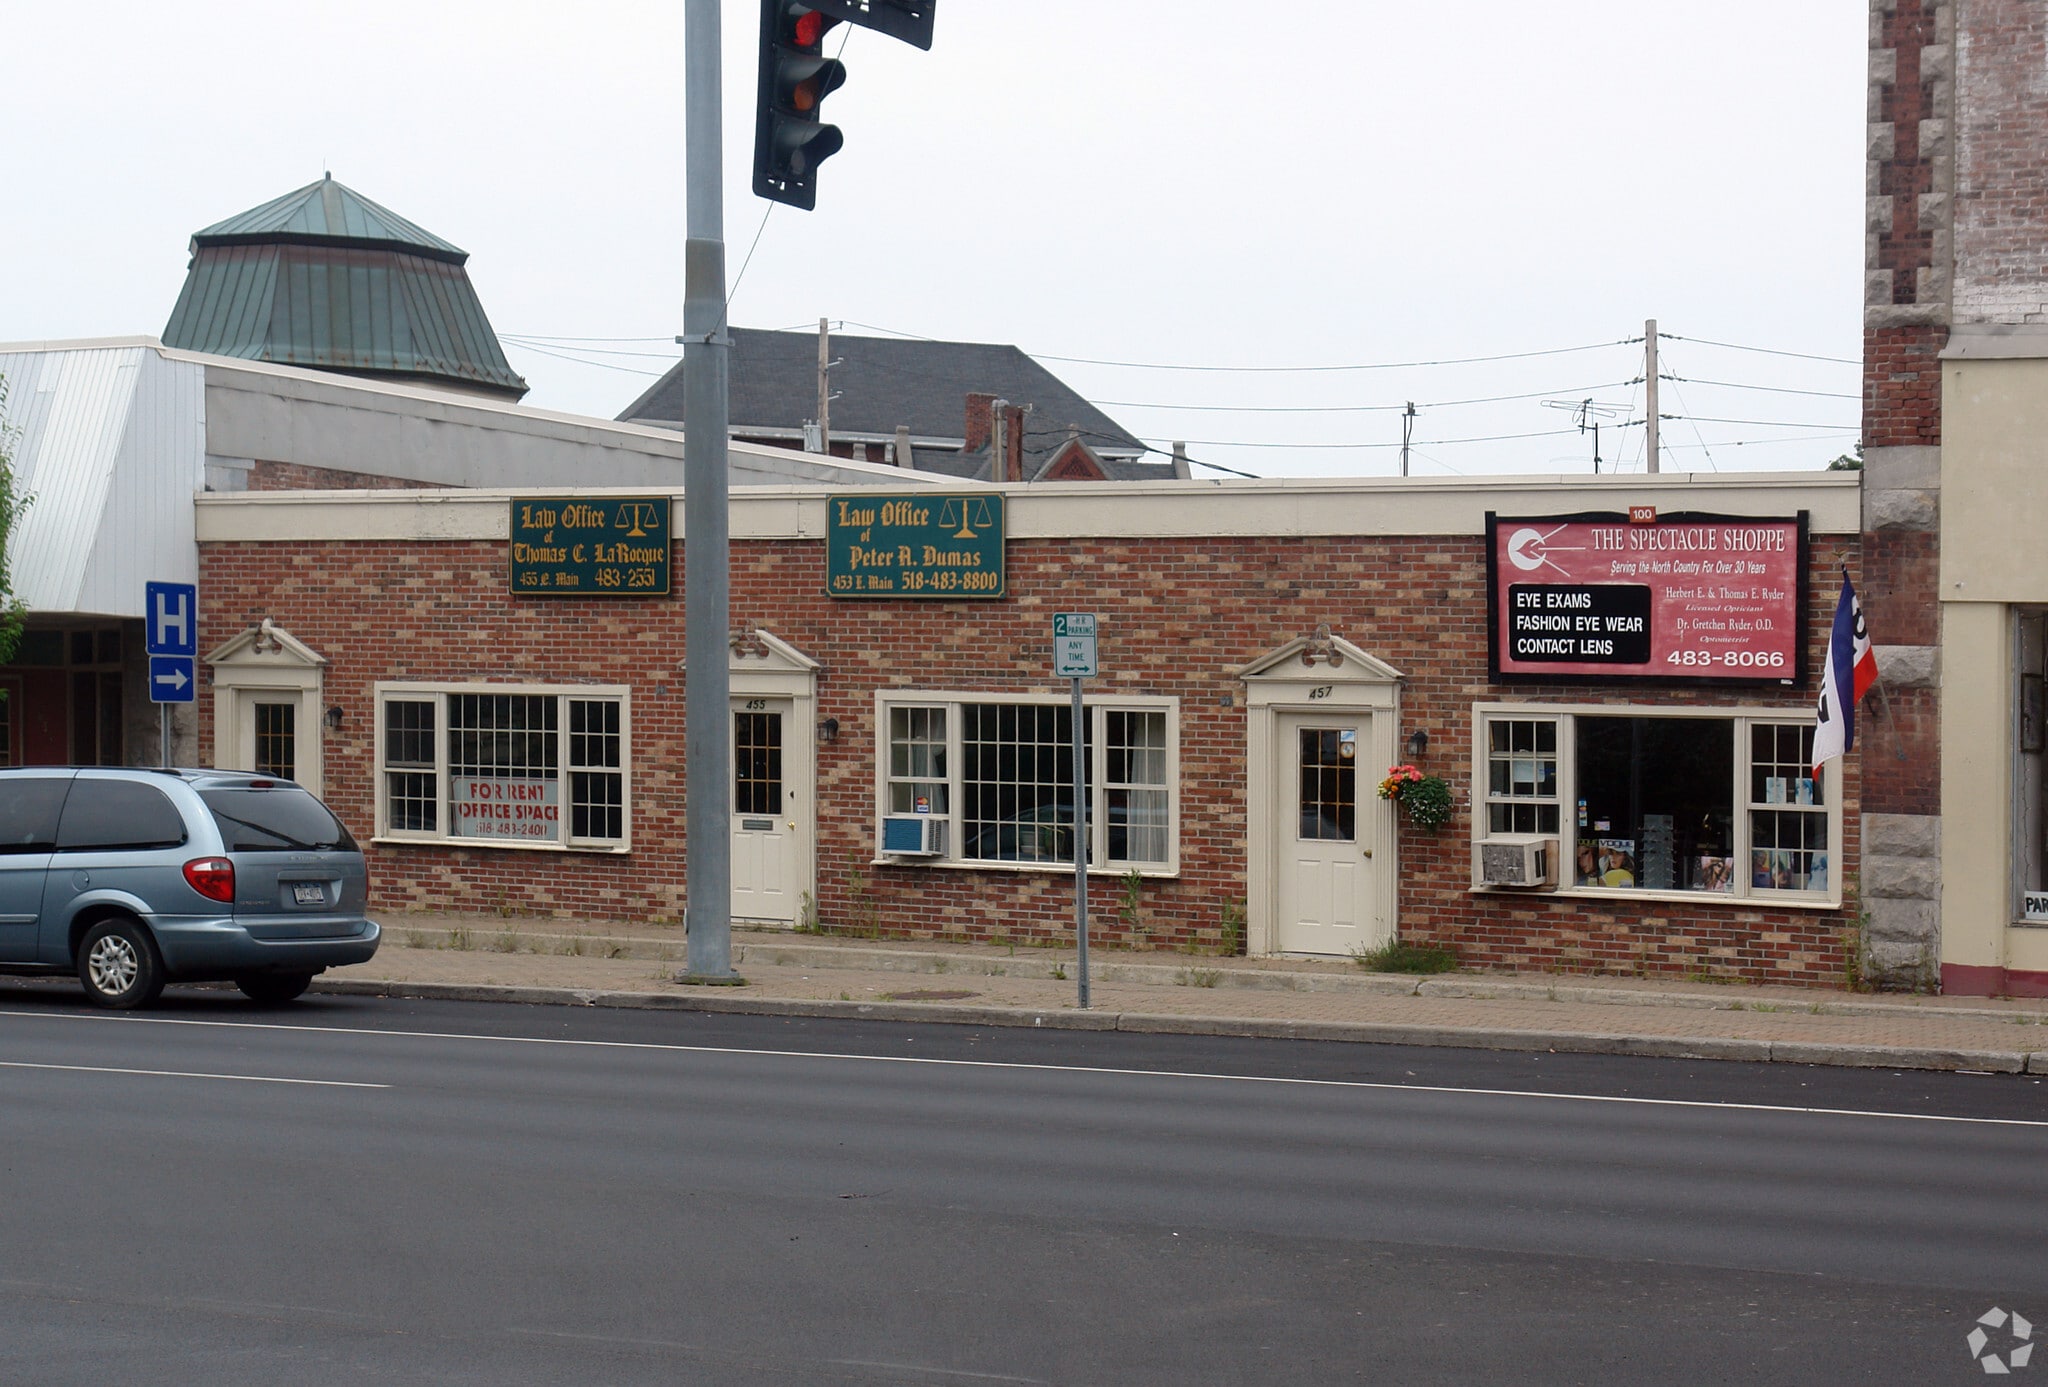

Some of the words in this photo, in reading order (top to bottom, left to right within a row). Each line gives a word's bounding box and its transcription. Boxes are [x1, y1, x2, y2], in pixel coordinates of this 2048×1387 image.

[522, 504, 556, 529] Law
[561, 504, 605, 529] Office
[838, 501, 875, 527] Law
[880, 501, 929, 527] Office
[1633, 509, 1652, 519] 100
[544, 530, 554, 543] of
[860, 528, 871, 542] of
[1591, 528, 1625, 550] THE
[1630, 528, 1717, 551] SPECTACLE
[1724, 529, 1785, 552] SHOPPE
[514, 542, 568, 564] Thomas
[572, 543, 588, 563] C.
[594, 542, 664, 566] LaRocque
[850, 545, 894, 570] Peter
[922, 545, 981, 566] Dumas
[1610, 560, 1636, 575] Serving
[1638, 560, 1650, 572] the
[1652, 560, 1671, 573] North
[1673, 560, 1700, 575] Country
[1702, 561, 1714, 573] For
[1716, 561, 1732, 573] Over
[1734, 561, 1744, 573] 30
[1747, 561, 1766, 574] Years
[519, 572, 538, 586] 455
[556, 572, 579, 586] Main
[833, 575, 853, 590] 453
[868, 575, 894, 590] Main
[902, 571, 998, 590] 518-483-8800
[1516, 593, 1542, 608] EYE
[1546, 593, 1591, 608] EXAMS
[1666, 586, 1694, 598] Herbert
[1697, 586, 1705, 598] E.
[1708, 587, 1716, 598] &
[1720, 587, 1748, 599] Thomas
[1752, 588, 1760, 600] E.
[1762, 588, 1784, 602] Ryder
[1685, 604, 1722, 612] Licensed
[1724, 605, 1764, 613] Opticians
[156, 593, 186, 646] H
[1056, 617, 1066, 633] 2
[1516, 616, 1570, 631] FASHION
[1576, 616, 1600, 632] EYE
[1606, 616, 1643, 632] WEAR
[1677, 618, 1690, 630] Dr.
[1692, 618, 1726, 630] Gretchen
[1729, 618, 1753, 632] Ryder,
[1756, 619, 1774, 630] O.D.
[1068, 626, 1093, 634] PARKING
[1068, 641, 1083, 650] ANY
[1517, 638, 1575, 654] CONTACT
[1580, 640, 1614, 655] LENS
[1068, 652, 1086, 661] TIME
[1667, 650, 1785, 667] 483-8066
[1308, 686, 1333, 700] 457
[746, 700, 766, 710] 455
[470, 783, 502, 799] FOR
[507, 784, 544, 800] RENT
[458, 802, 510, 818] OFFICE
[516, 804, 558, 821] SPACE
[1600, 840, 1631, 848] VOGUE
